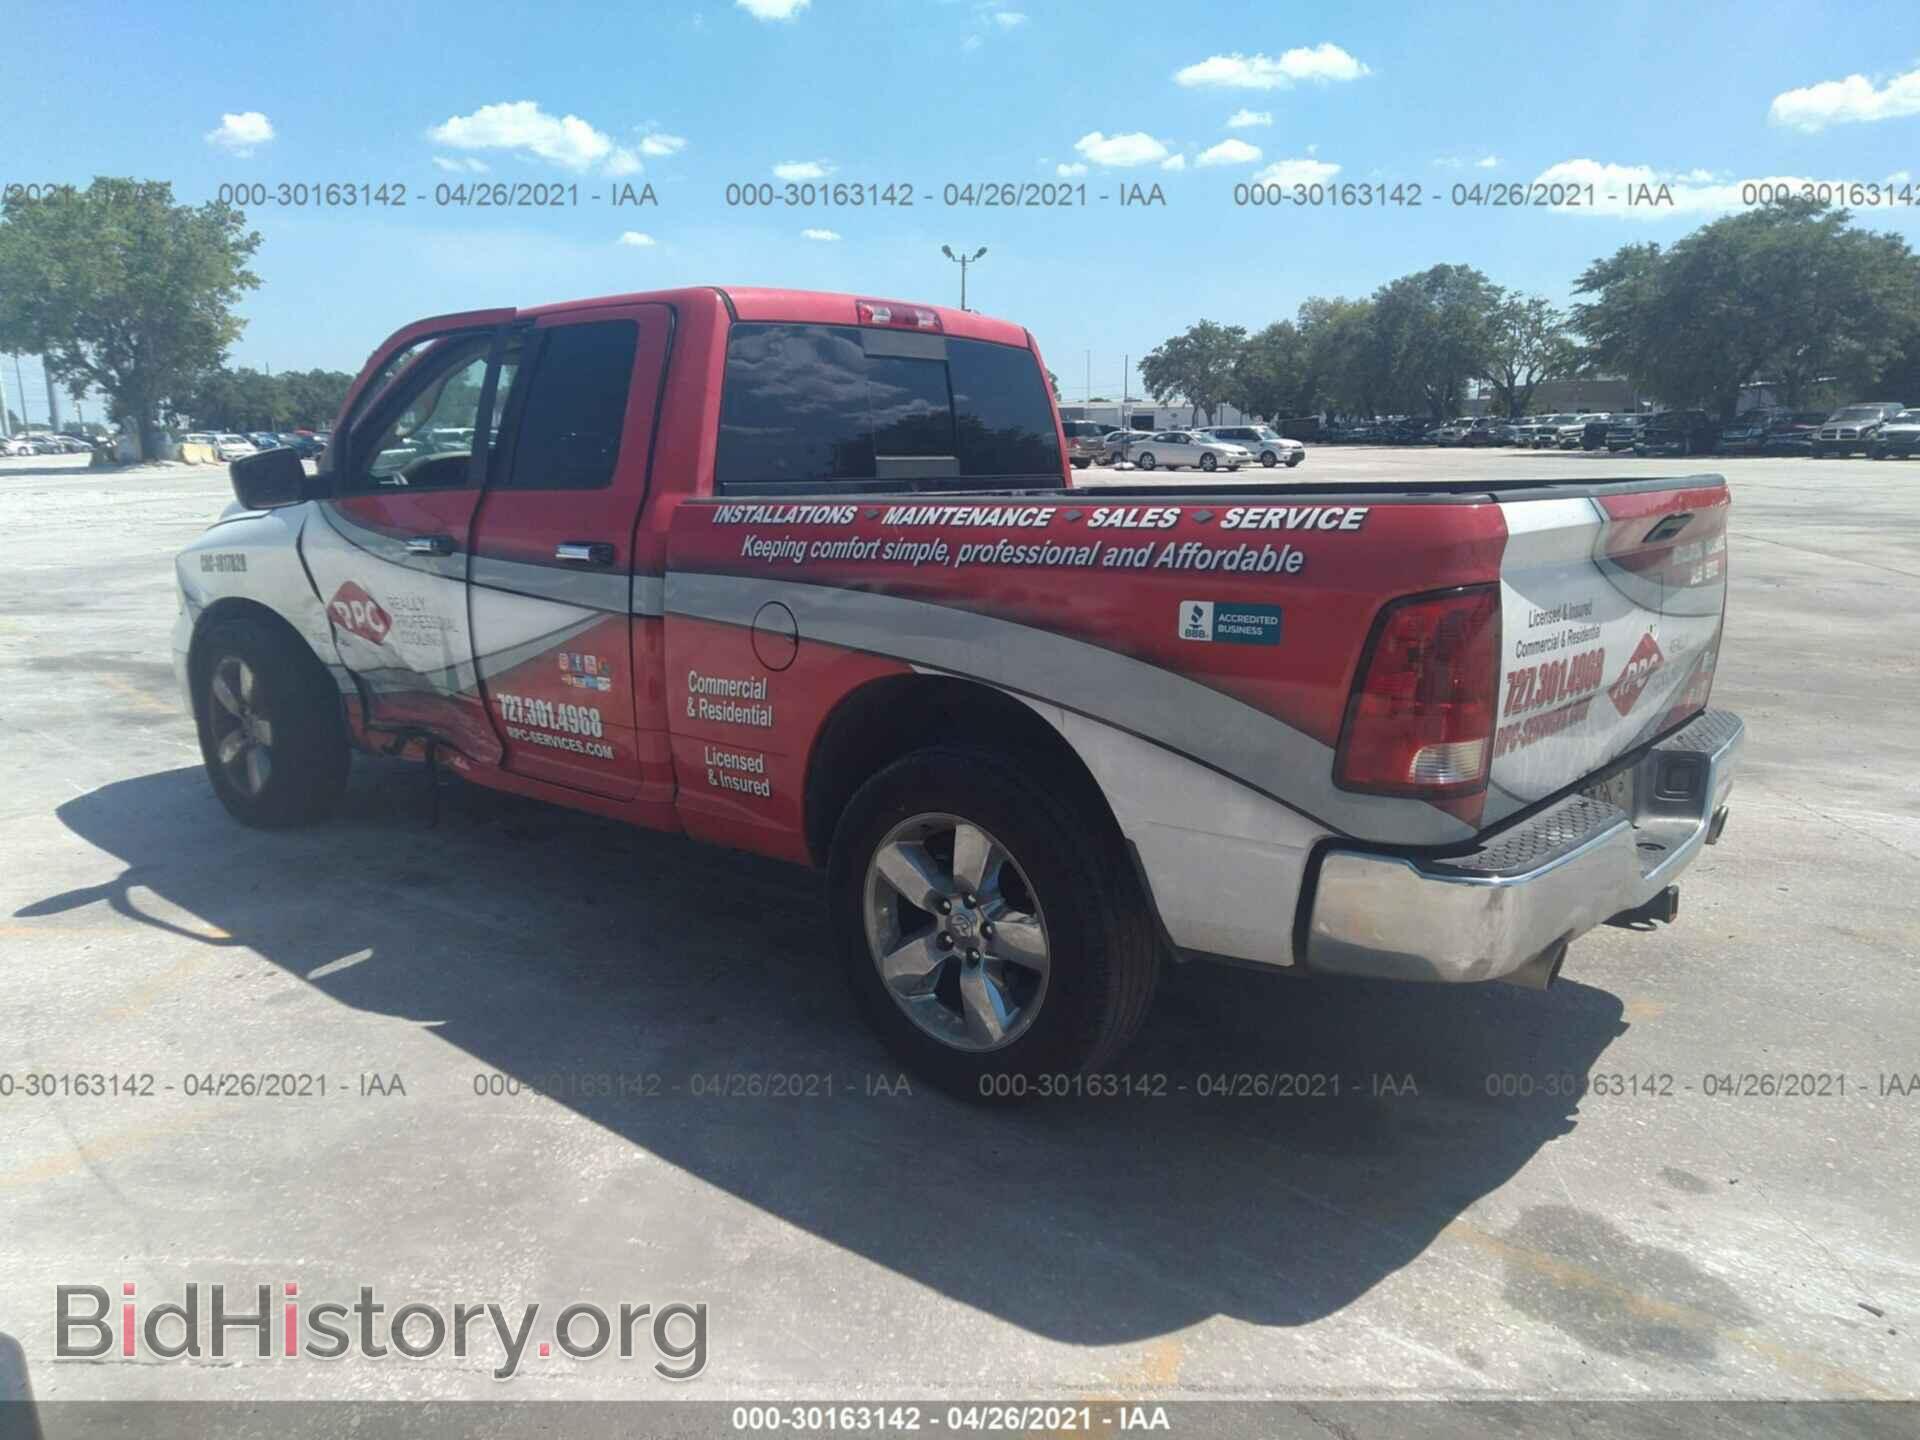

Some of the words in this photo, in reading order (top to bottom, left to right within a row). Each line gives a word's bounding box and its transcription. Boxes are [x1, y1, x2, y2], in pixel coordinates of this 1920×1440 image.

[712, 505, 857, 525] INSTALLATIONS
[881, 506, 1056, 527] MAINTENANCE
[1087, 507, 1182, 529] SALES
[1220, 507, 1369, 531] SERVICE
[741, 535, 805, 563] Keeping
[810, 536, 881, 560] comfort
[882, 538, 950, 566] simple,
[955, 539, 1101, 568] professional
[1103, 541, 1155, 568] and
[1154, 542, 1304, 573] Affordable
[1218, 613, 1278, 625] ACCREDITED
[1218, 624, 1263, 636] BUSINESS
[1528, 603, 1561, 629] Licensed
[1516, 631, 1560, 659] Commercial
[688, 670, 767, 700] Commercial
[496, 692, 603, 738] 727.301.4968
[687, 697, 696, 718] &
[699, 698, 772, 727] Residential
[705, 746, 764, 773] Licensed
[708, 768, 718, 786] &
[720, 771, 770, 797] Insured
